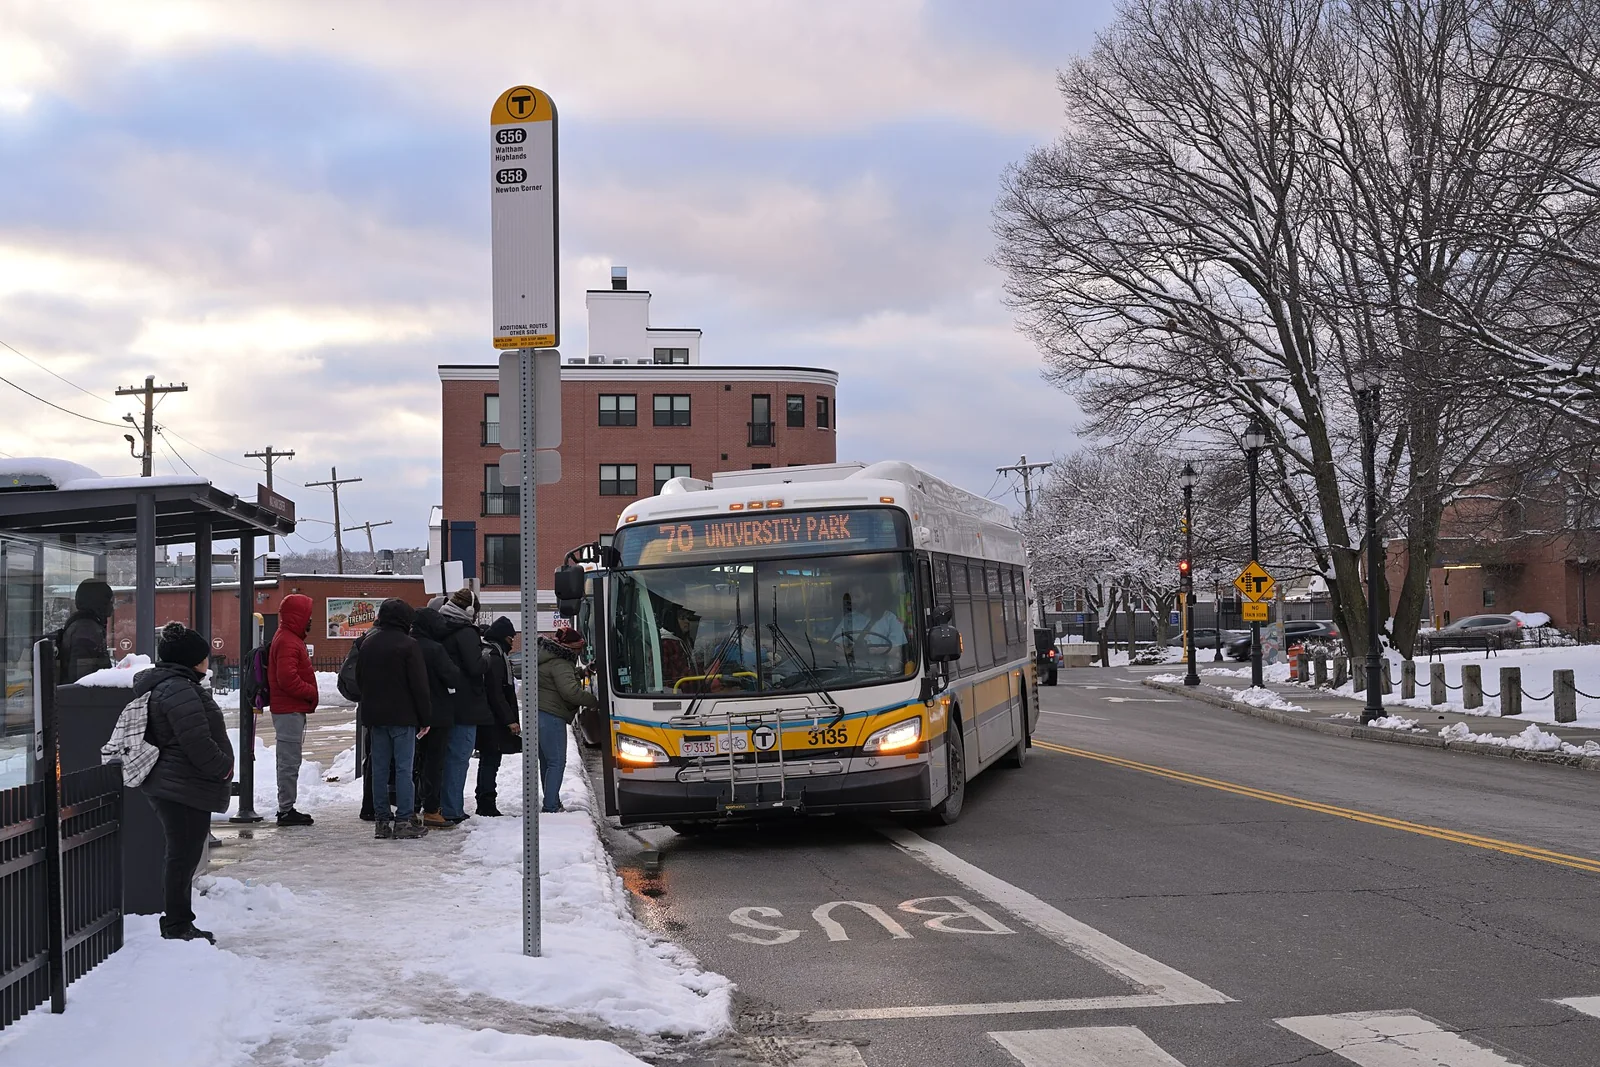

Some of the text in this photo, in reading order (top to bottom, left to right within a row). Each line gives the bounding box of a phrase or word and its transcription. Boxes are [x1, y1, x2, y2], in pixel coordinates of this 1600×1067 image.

[511, 95, 531, 114] T
[500, 130, 523, 143] 556
[495, 153, 527, 162] Highlands
[500, 169, 523, 183] 558
[521, 184, 542, 192] Corner
[659, 514, 850, 553] 70 UNIVERSITY PARK
[349, 611, 375, 624] TRENCITO
[756, 733, 772, 747] T
[808, 728, 848, 746] 3135
[693, 742, 715, 753] 3135
[728, 896, 1018, 945] BUS
